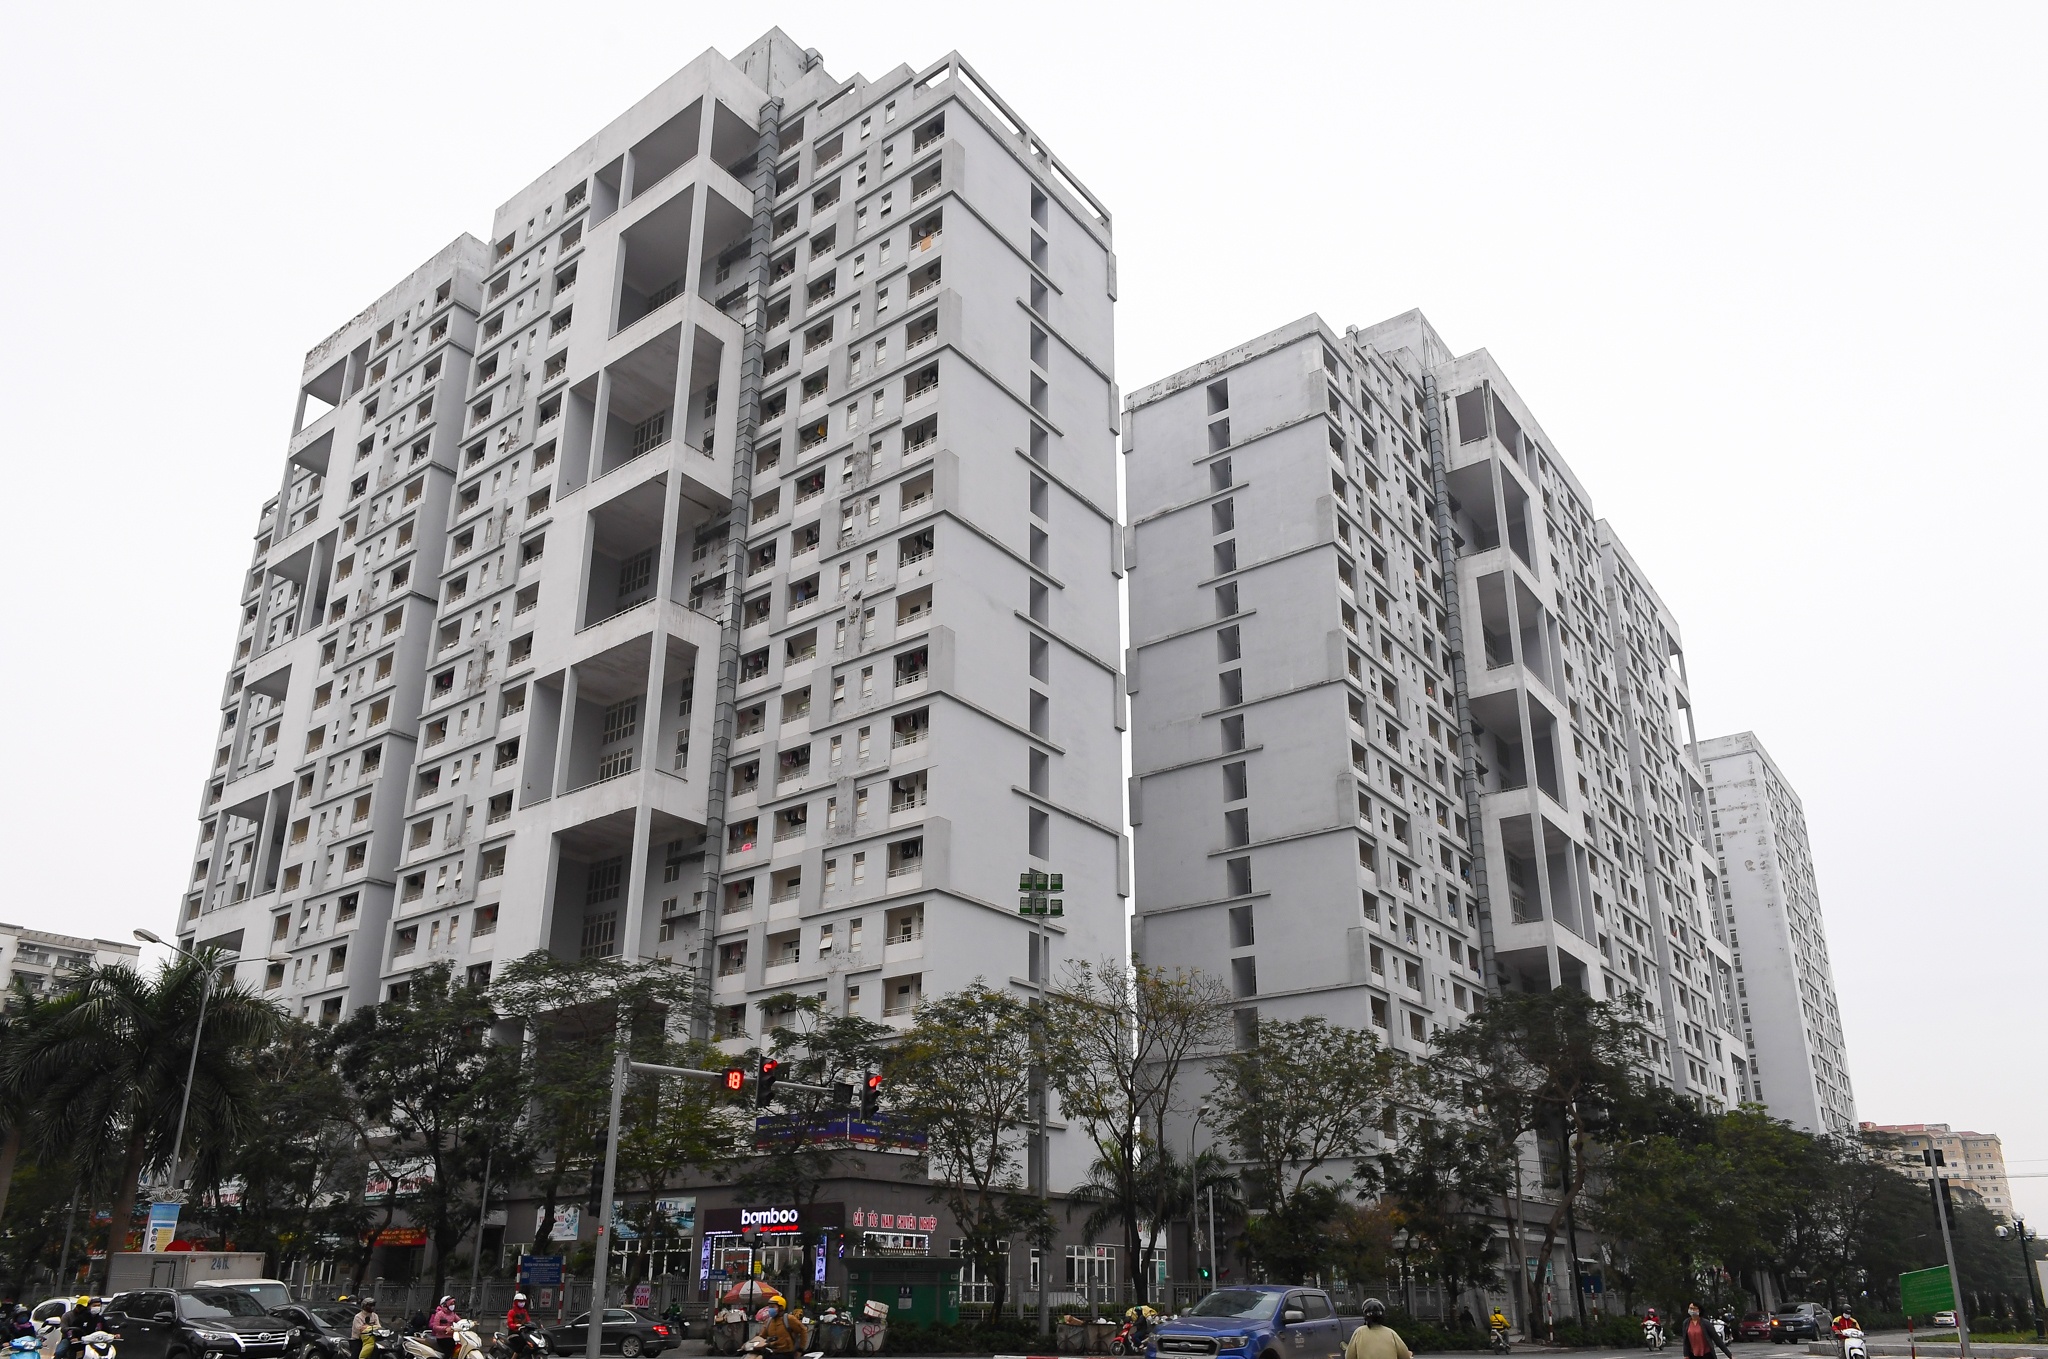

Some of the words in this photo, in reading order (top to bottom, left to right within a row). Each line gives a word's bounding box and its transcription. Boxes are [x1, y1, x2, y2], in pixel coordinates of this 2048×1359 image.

[728, 1071, 741, 1089] 18
[741, 1207, 798, 1225] bamboo
[867, 1210, 879, 1227] TÓC
[881, 1213, 894, 1229] NAM
[897, 1212, 917, 1230] CHUYÊN
